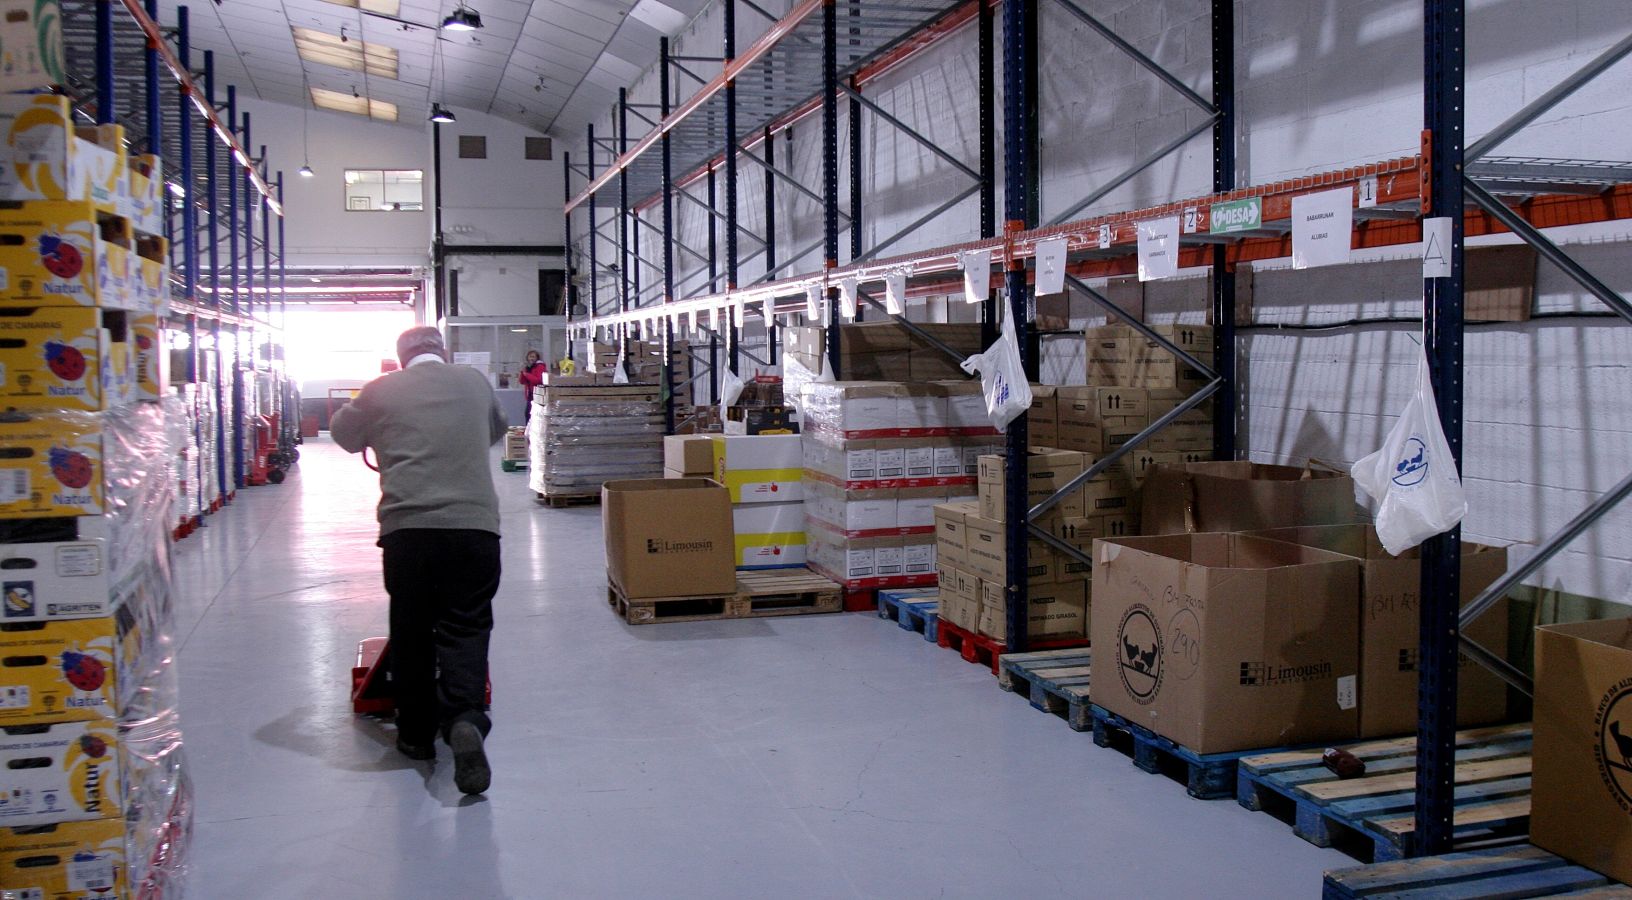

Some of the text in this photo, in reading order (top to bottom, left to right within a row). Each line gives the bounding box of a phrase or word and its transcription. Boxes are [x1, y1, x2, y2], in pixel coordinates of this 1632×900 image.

[1364, 181, 1372, 201] 1
[1188, 211, 1194, 228] 2
[1226, 207, 1249, 225] DESA
[1103, 228, 1109, 243] 3
[1310, 232, 1329, 241] ALUBIAS
[1423, 231, 1447, 265] A
[43, 282, 83, 295] Natur
[137, 352, 147, 383] Natur
[48, 385, 87, 396] Natur
[53, 494, 93, 505] Natur
[665, 539, 713, 551] Limousin
[1267, 659, 1331, 681] Limousin
[66, 697, 106, 707] Natur
[1594, 694, 1610, 725] BANCO
[85, 763, 101, 812] Natur
